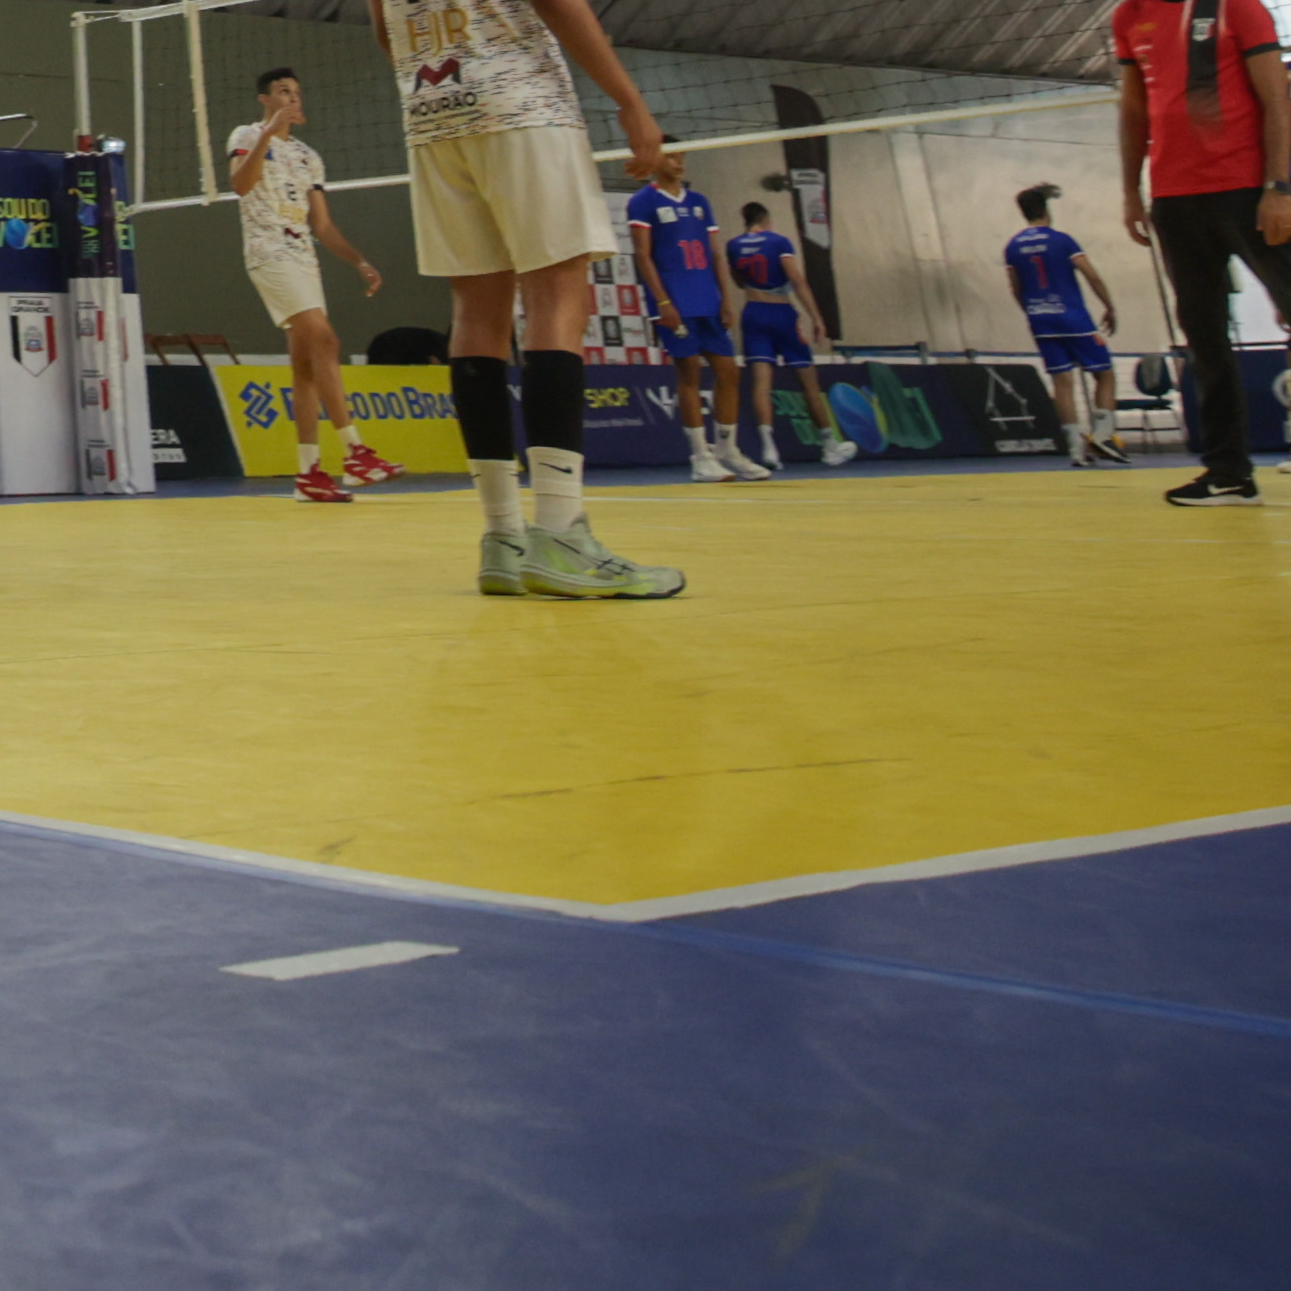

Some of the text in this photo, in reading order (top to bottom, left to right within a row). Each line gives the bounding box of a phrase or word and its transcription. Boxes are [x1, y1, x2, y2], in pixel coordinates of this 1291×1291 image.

[406, 7, 472, 57] HJR
[1031, 256, 1049, 289] 1
[368, 392, 405, 420] DO
